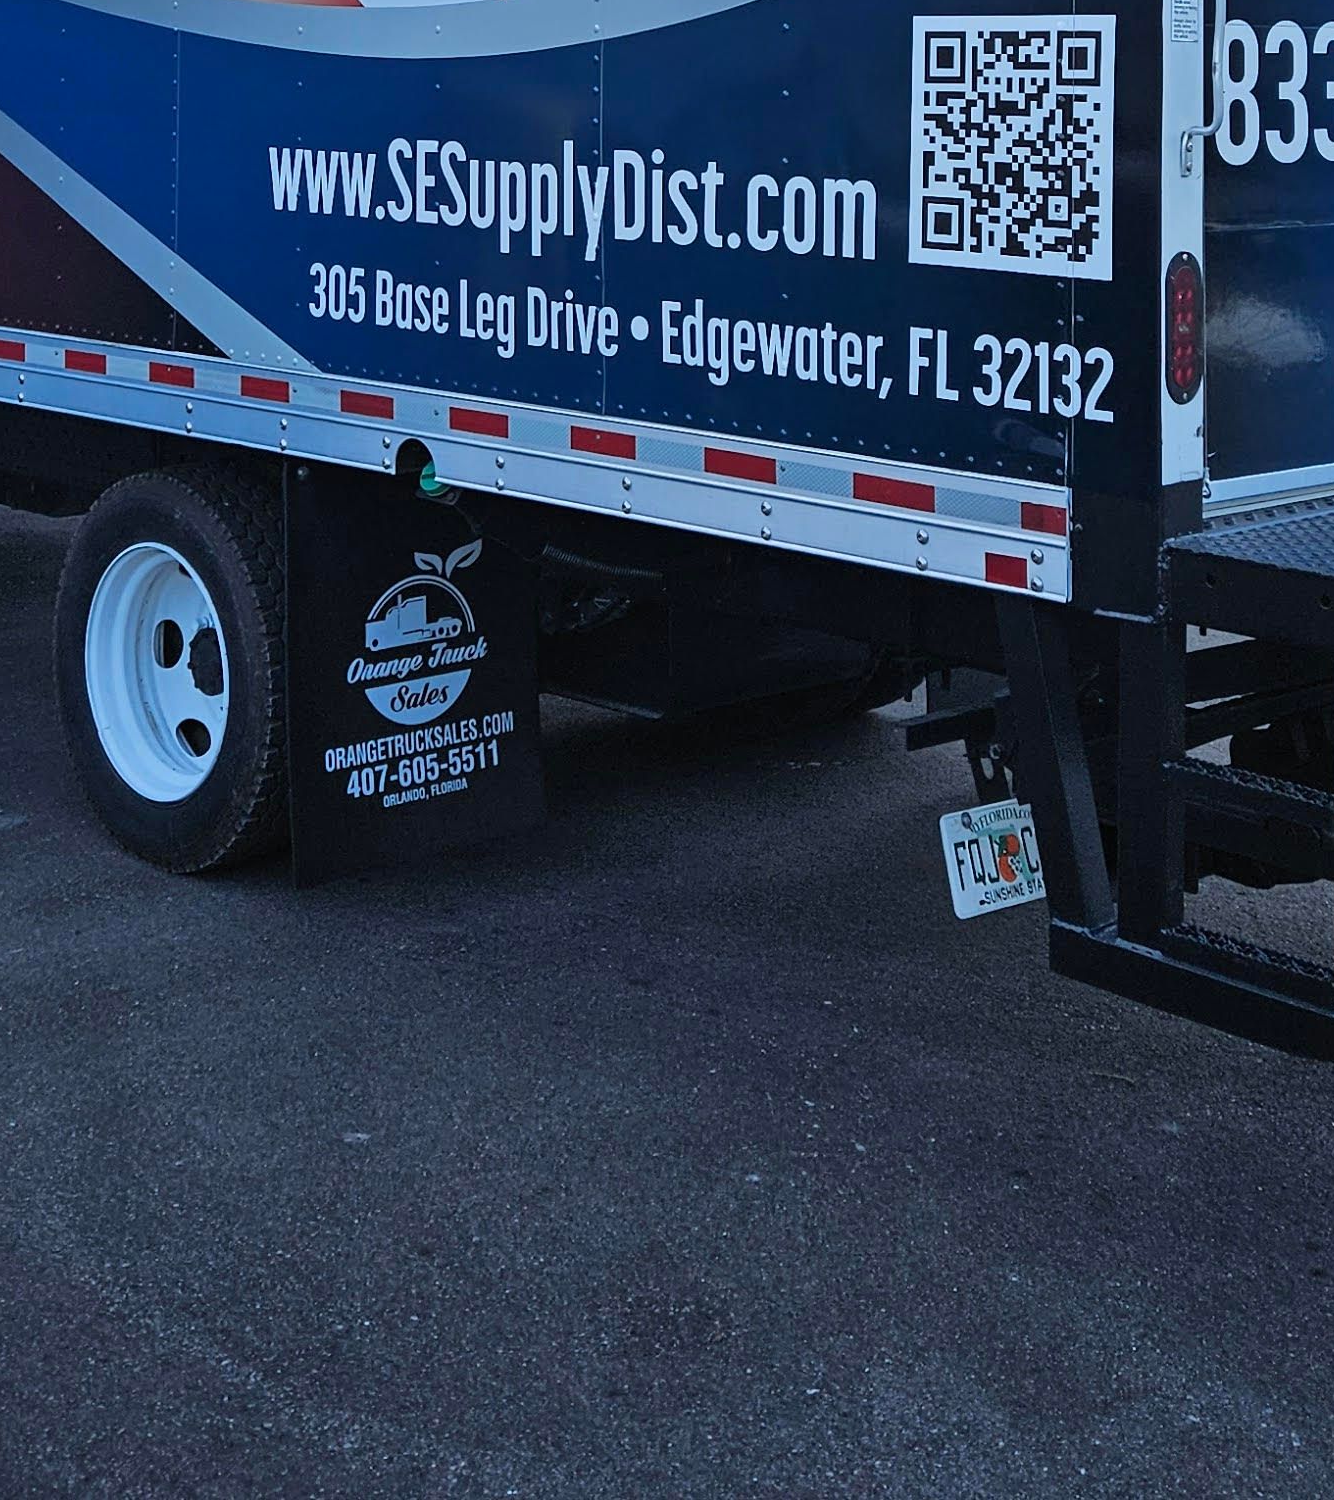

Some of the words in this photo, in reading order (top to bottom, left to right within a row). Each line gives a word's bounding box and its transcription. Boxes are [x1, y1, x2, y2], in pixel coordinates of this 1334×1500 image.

[268, 138, 878, 261] www.SESupplyDist.com
[308, 263, 366, 322] 305
[375, 271, 450, 335] Base
[458, 279, 516, 358] Leg
[527, 287, 620, 358] Drive
[661, 300, 893, 400] Edgewater,
[908, 327, 960, 402] FL
[972, 334, 1115, 422] 32132
[346, 654, 423, 684] Orange
[428, 636, 488, 668] Truck
[390, 682, 450, 713] Sales
[324, 710, 514, 773] ORANGETRUCKSALES.COM
[346, 738, 499, 798] 407-605-5511
[383, 788, 430, 808] ORLANDO,
[430, 777, 468, 797] FLORIDA
[984, 882, 1026, 905] SUNSHINE
[1027, 877, 1044, 894] STA
